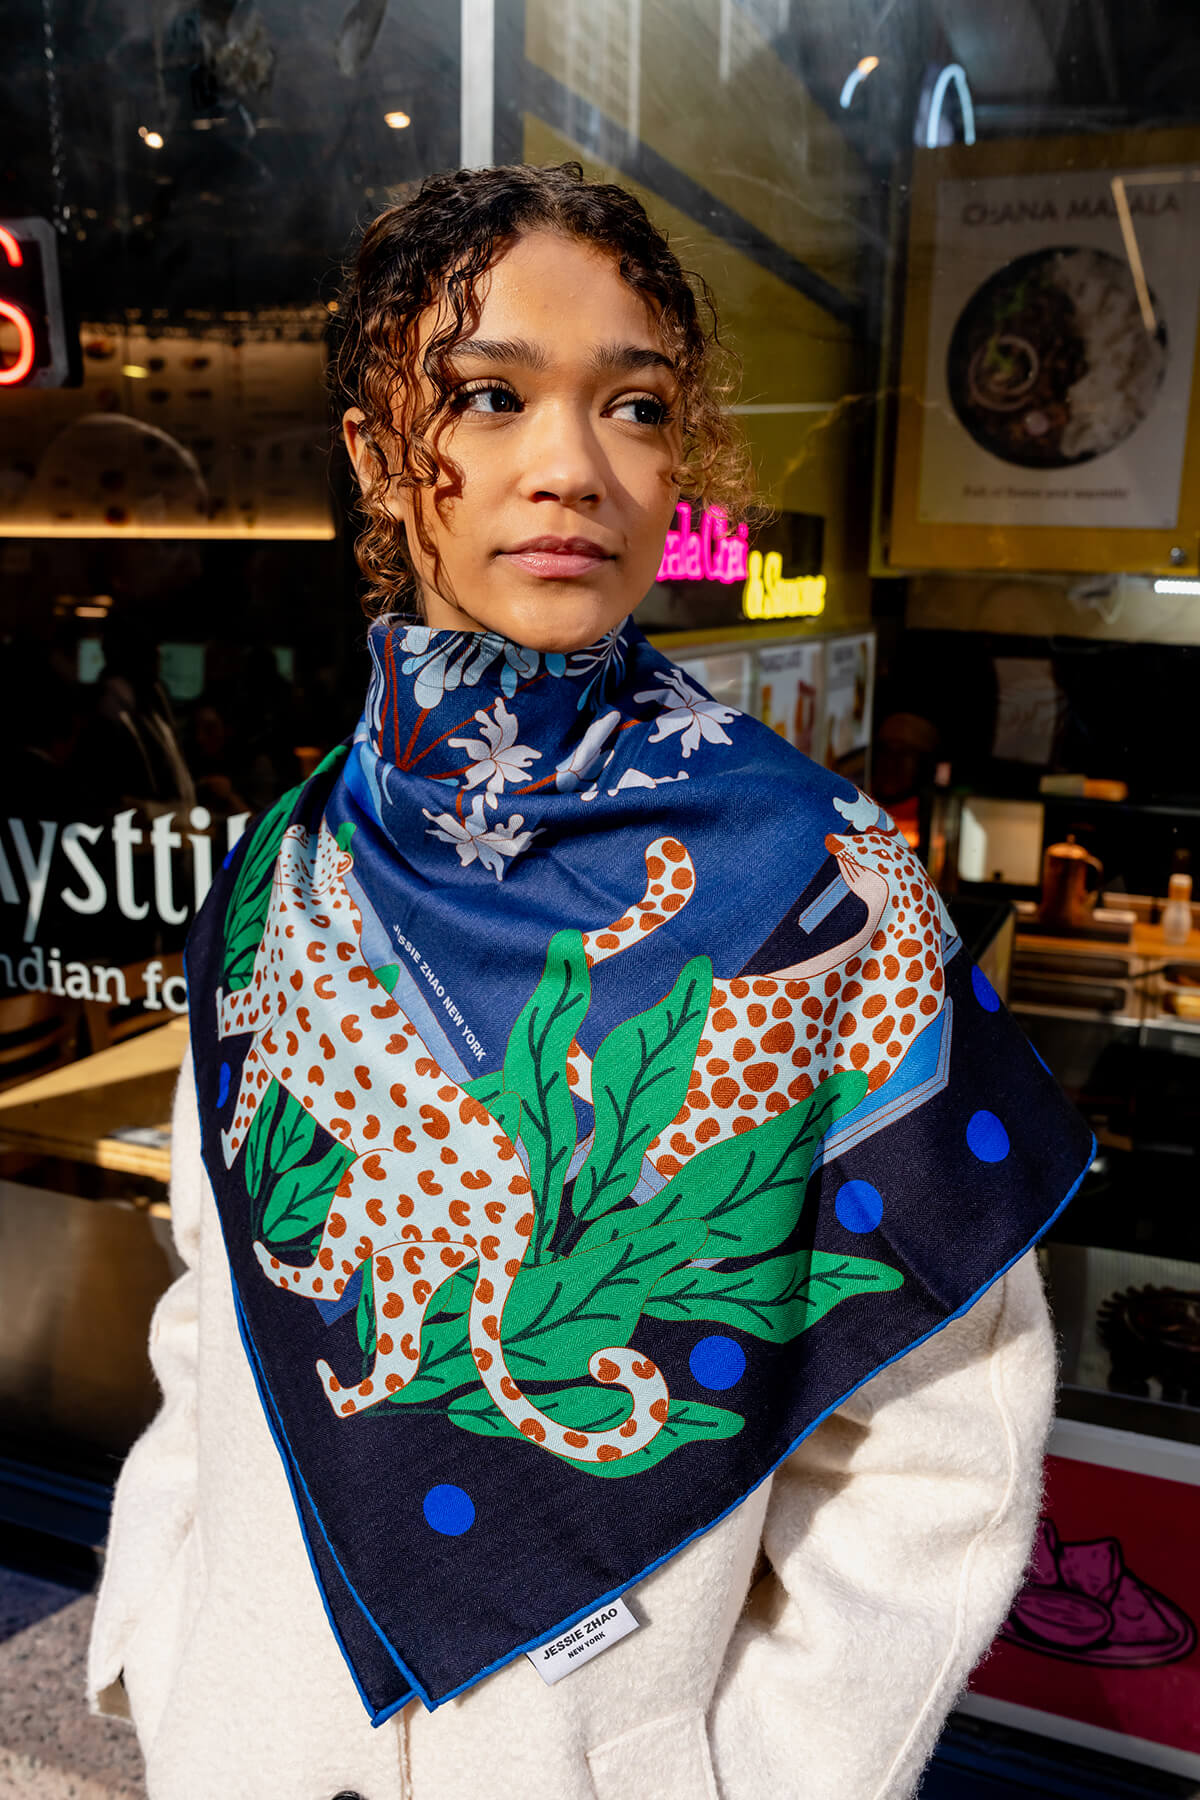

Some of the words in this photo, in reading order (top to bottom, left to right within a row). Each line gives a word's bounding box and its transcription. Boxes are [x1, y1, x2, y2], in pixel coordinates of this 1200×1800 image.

[1065, 192, 1180, 221] MAALA
[0, 806, 251, 942] ystti
[420, 961, 445, 997] ZHAO
[442, 996, 464, 1027] NEW
[461, 1025, 487, 1062] YORK
[543, 1629, 585, 1661] JESSIE
[583, 1607, 618, 1635] ZHAO
[567, 1645, 585, 1659] NEW
[583, 1631, 606, 1648] YORK
